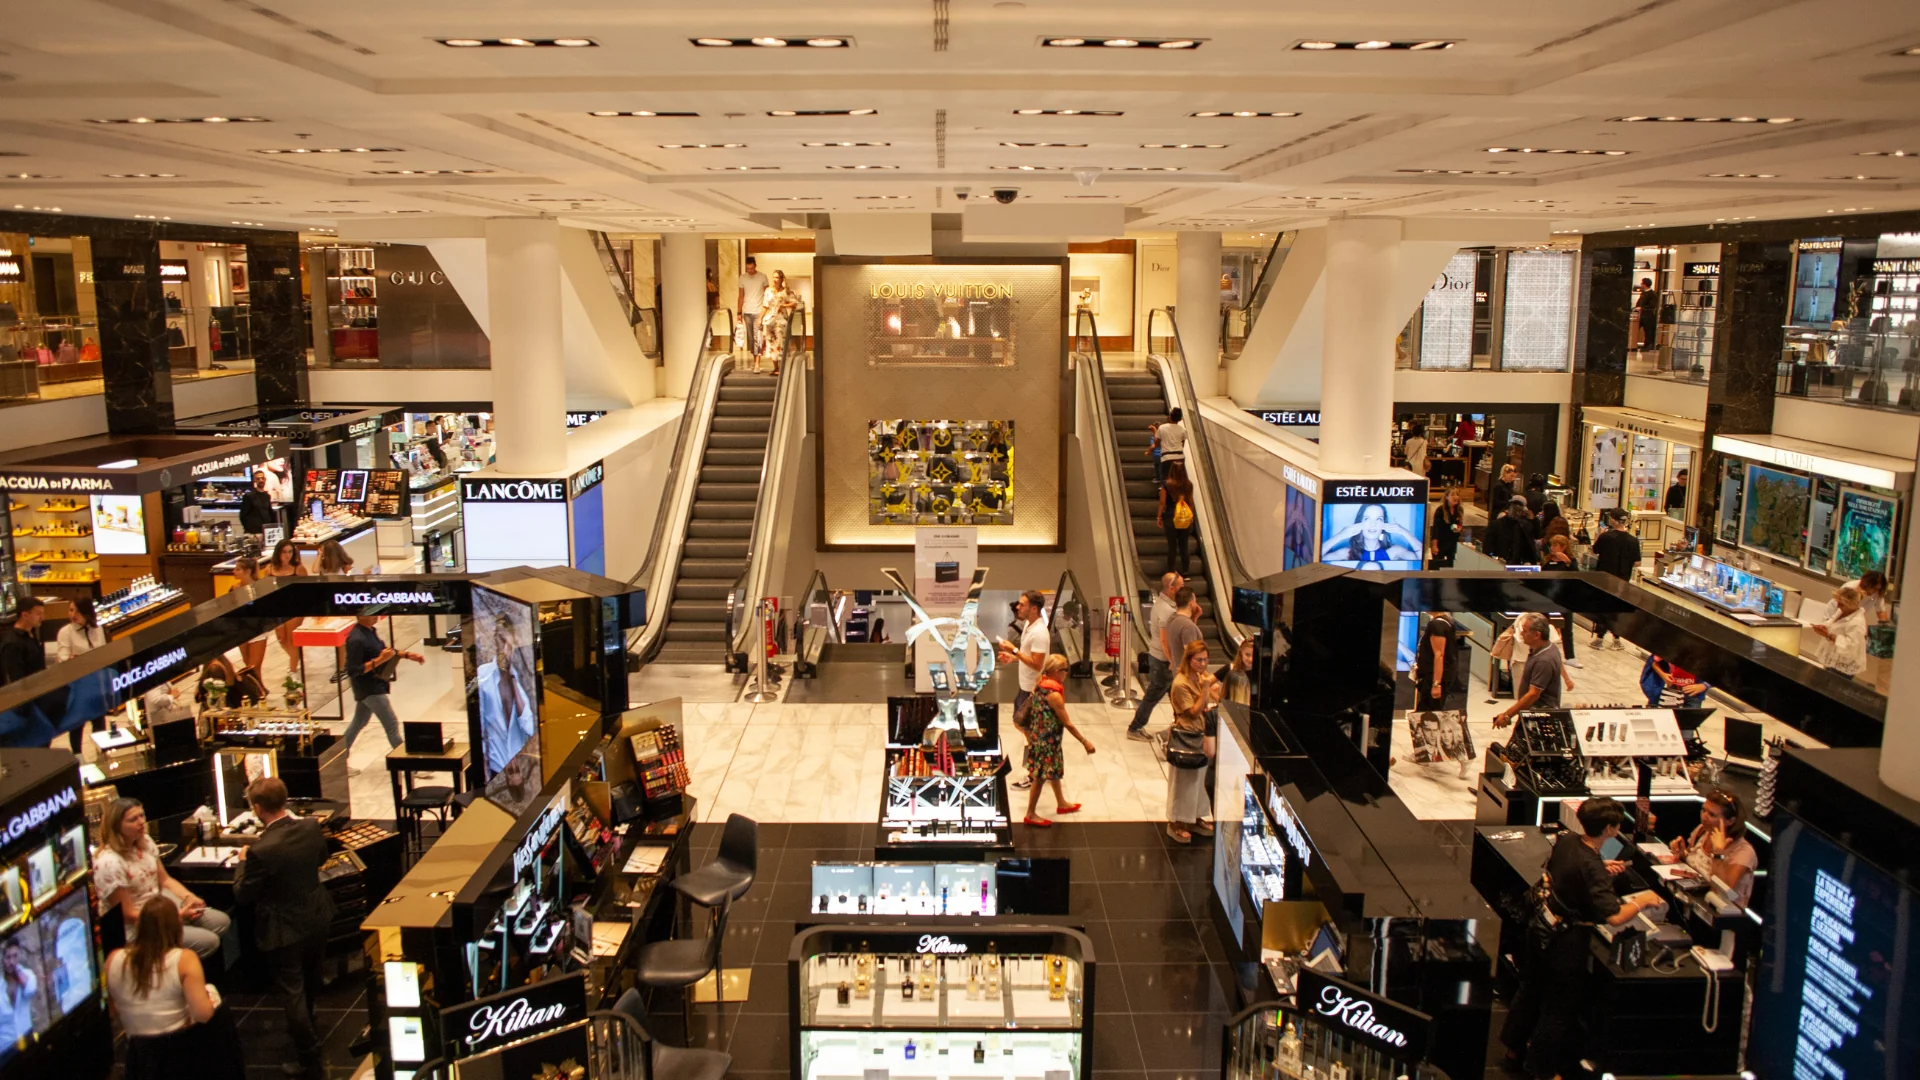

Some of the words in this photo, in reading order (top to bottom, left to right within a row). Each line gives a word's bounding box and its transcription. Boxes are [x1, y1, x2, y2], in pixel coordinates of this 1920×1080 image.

[1151, 262, 1170, 272] Dior
[871, 284, 925, 298] LOUIS
[931, 284, 1013, 299] VUITTON
[349, 420, 377, 434] GUERLAIN
[1628, 423, 1659, 437] MALONE
[191, 460, 219, 476] ACQUA
[224, 453, 251, 467] PARMA
[0, 477, 49, 490] ACQUA
[62, 478, 113, 490] PARMA
[465, 481, 563, 500] LANCÔME
[1370, 487, 1415, 497] LAUDER
[916, 934, 968, 953] Kilian
[465, 997, 566, 1045] Kilian
[1316, 985, 1408, 1048] Kilian
